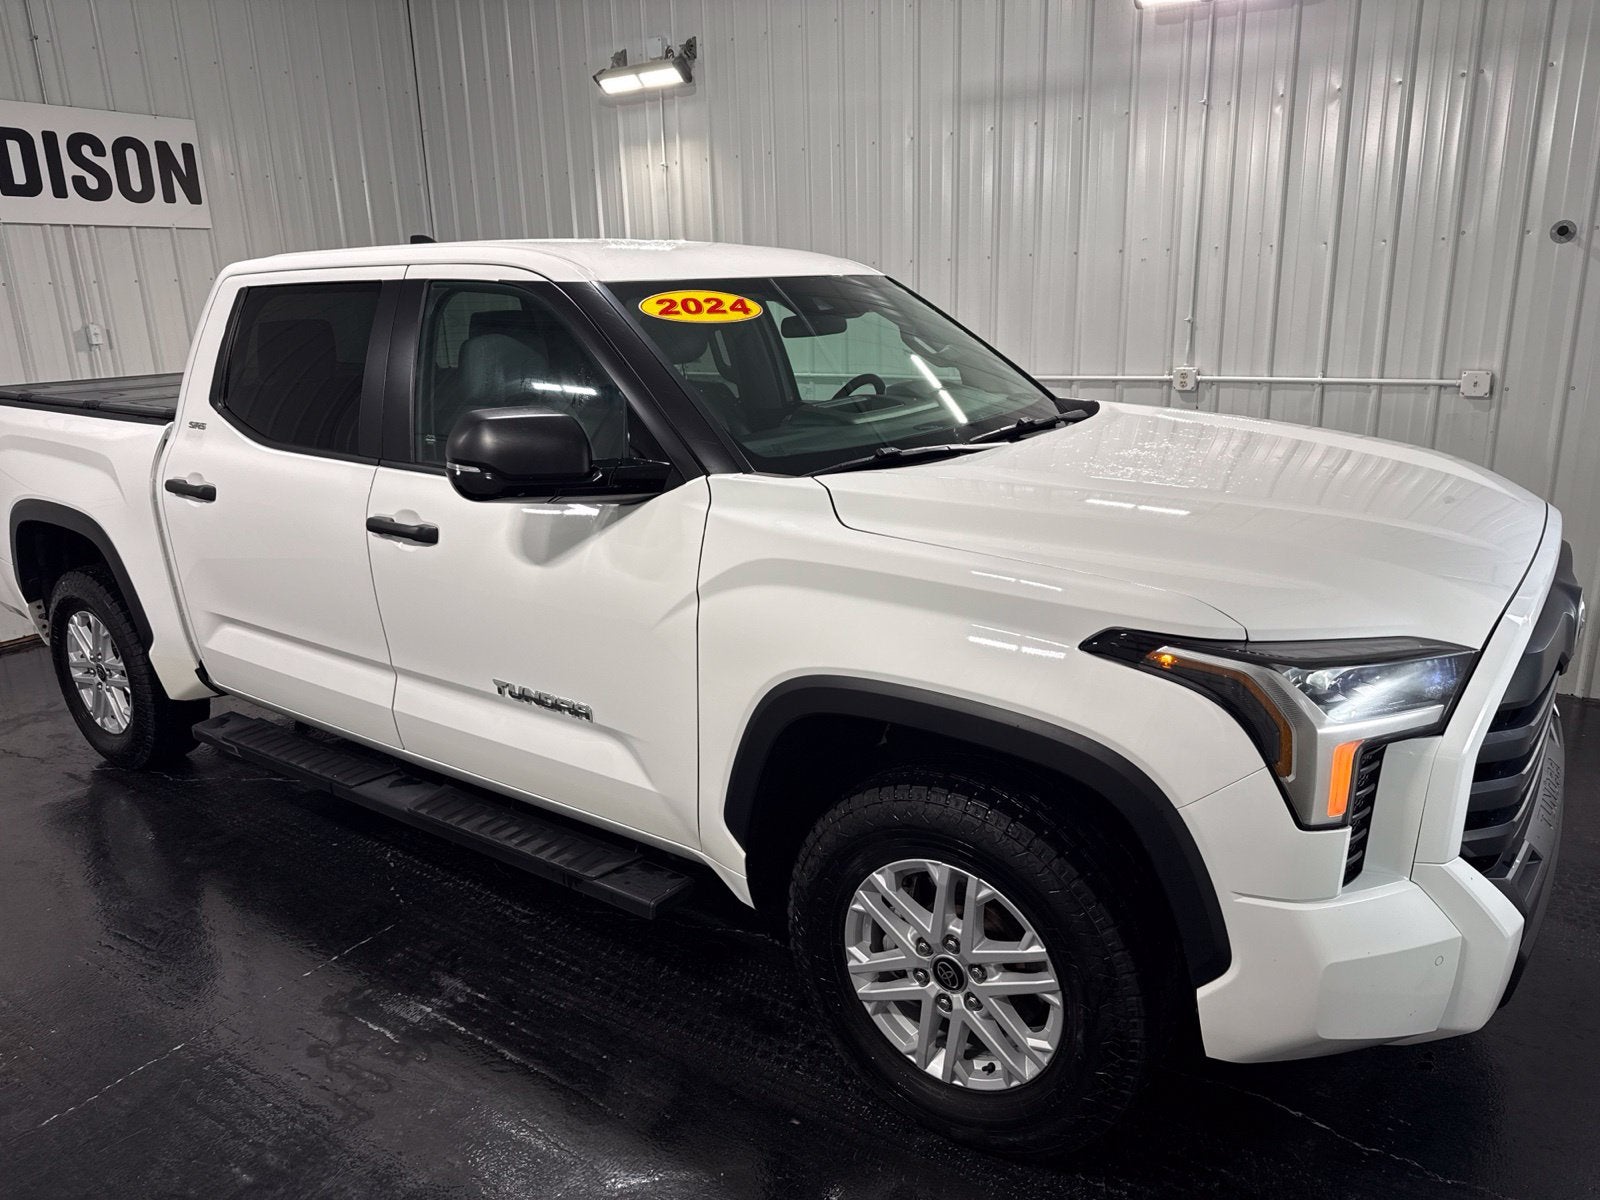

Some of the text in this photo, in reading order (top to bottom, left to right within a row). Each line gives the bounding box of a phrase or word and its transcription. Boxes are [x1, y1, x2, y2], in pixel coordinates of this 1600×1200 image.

[0, 126, 202, 205] DISON
[655, 297, 751, 316] 2024
[492, 678, 593, 723] TUNDRA
